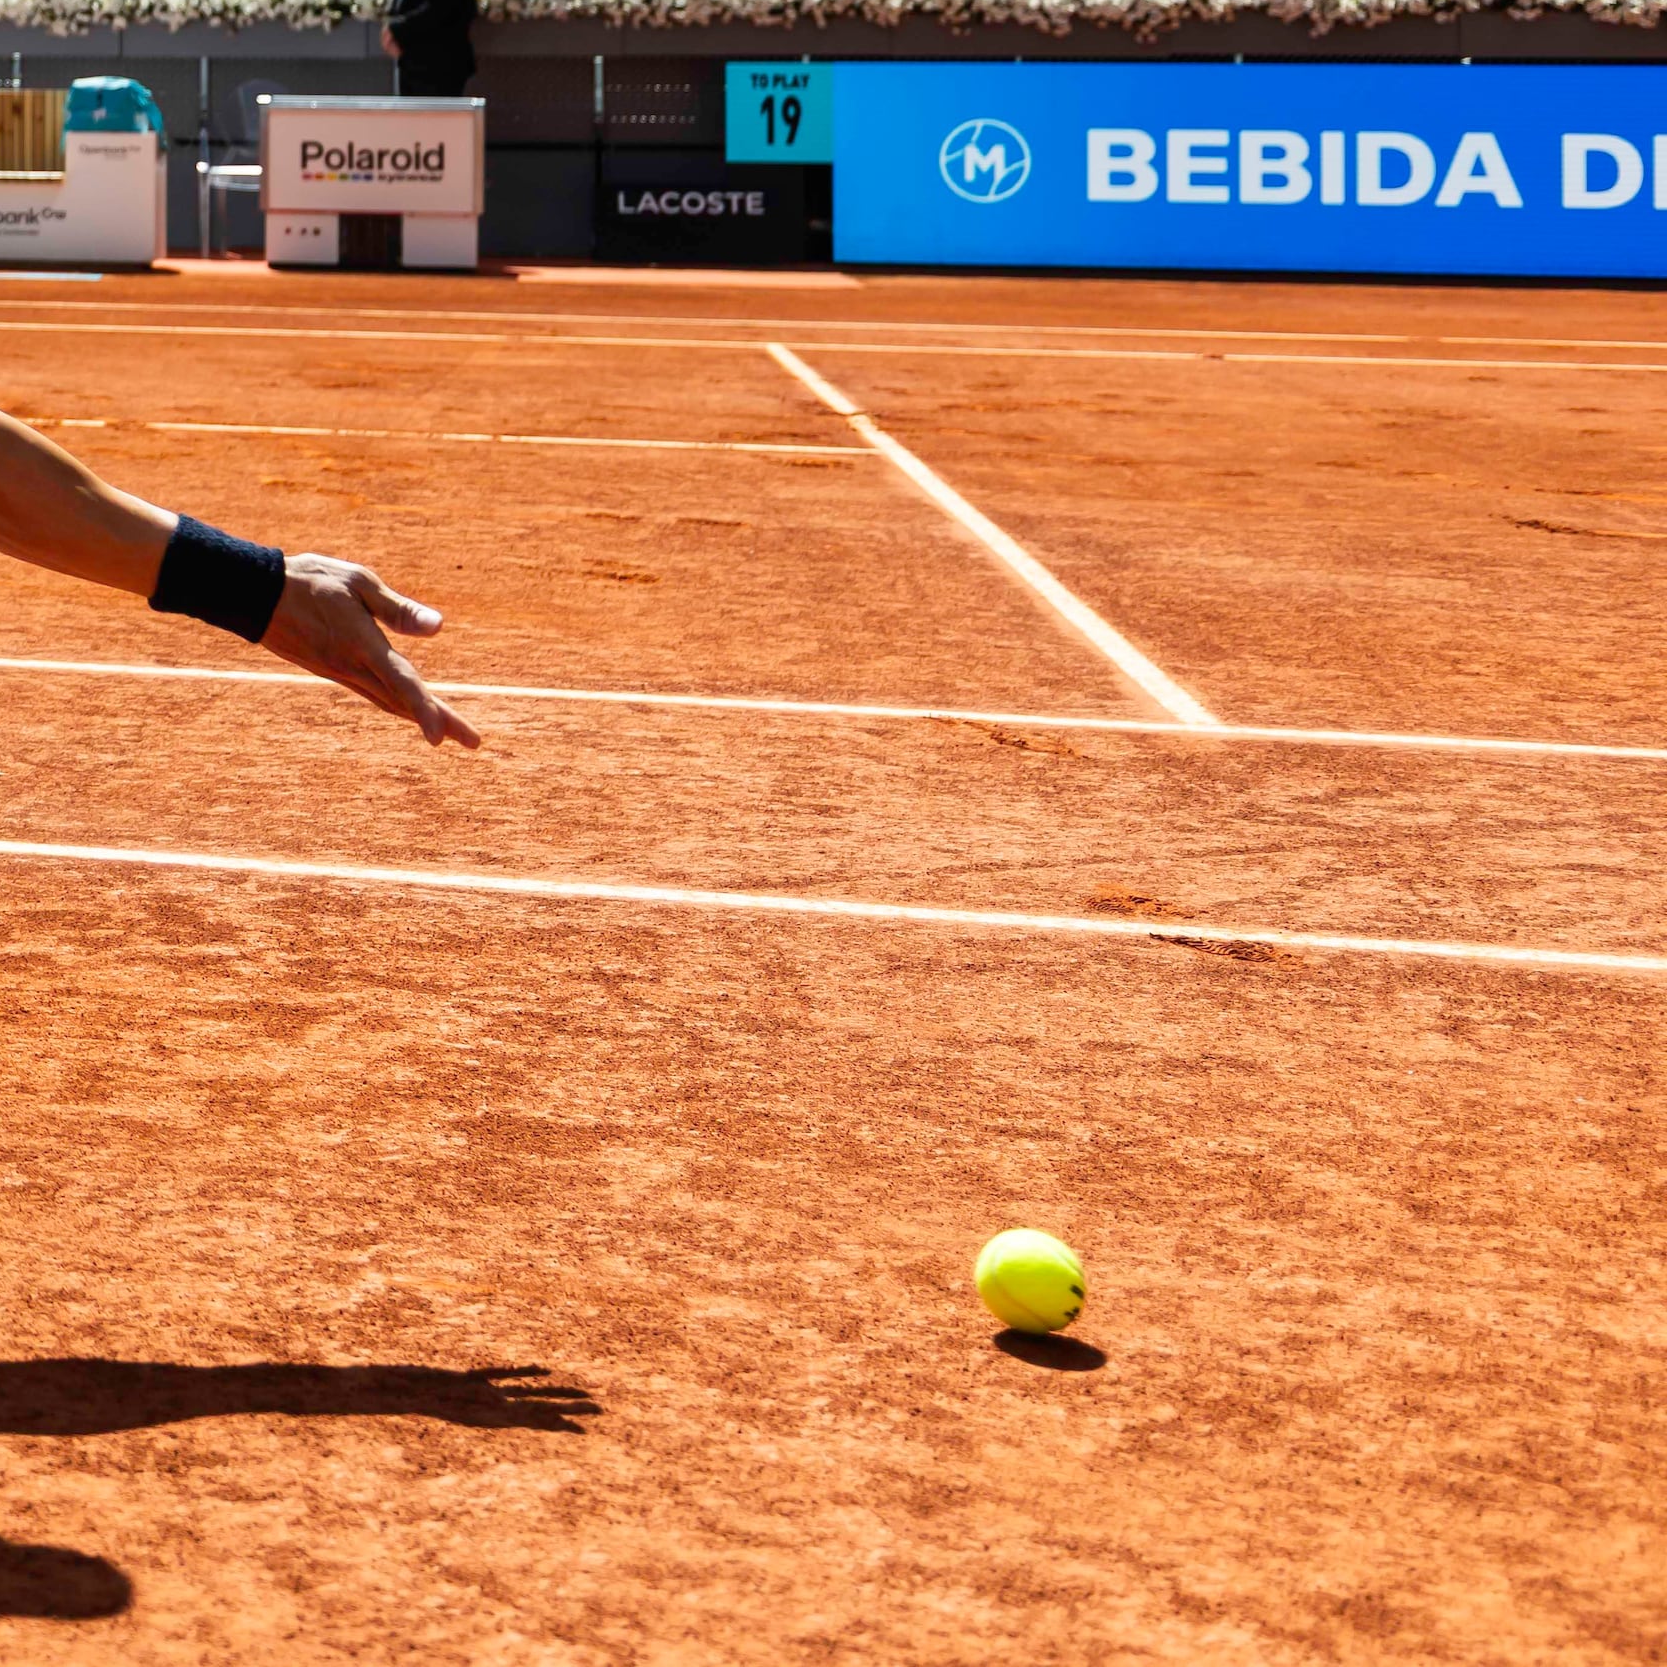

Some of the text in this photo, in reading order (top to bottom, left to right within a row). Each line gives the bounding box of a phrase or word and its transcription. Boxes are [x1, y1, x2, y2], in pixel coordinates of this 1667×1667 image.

[751, 73, 810, 89] TO PLAY
[760, 95, 802, 147] 19
[301, 141, 445, 171] Polaroid
[1086, 128, 1667, 211] BEBIDA D
[617, 191, 765, 215] LACOSTE
